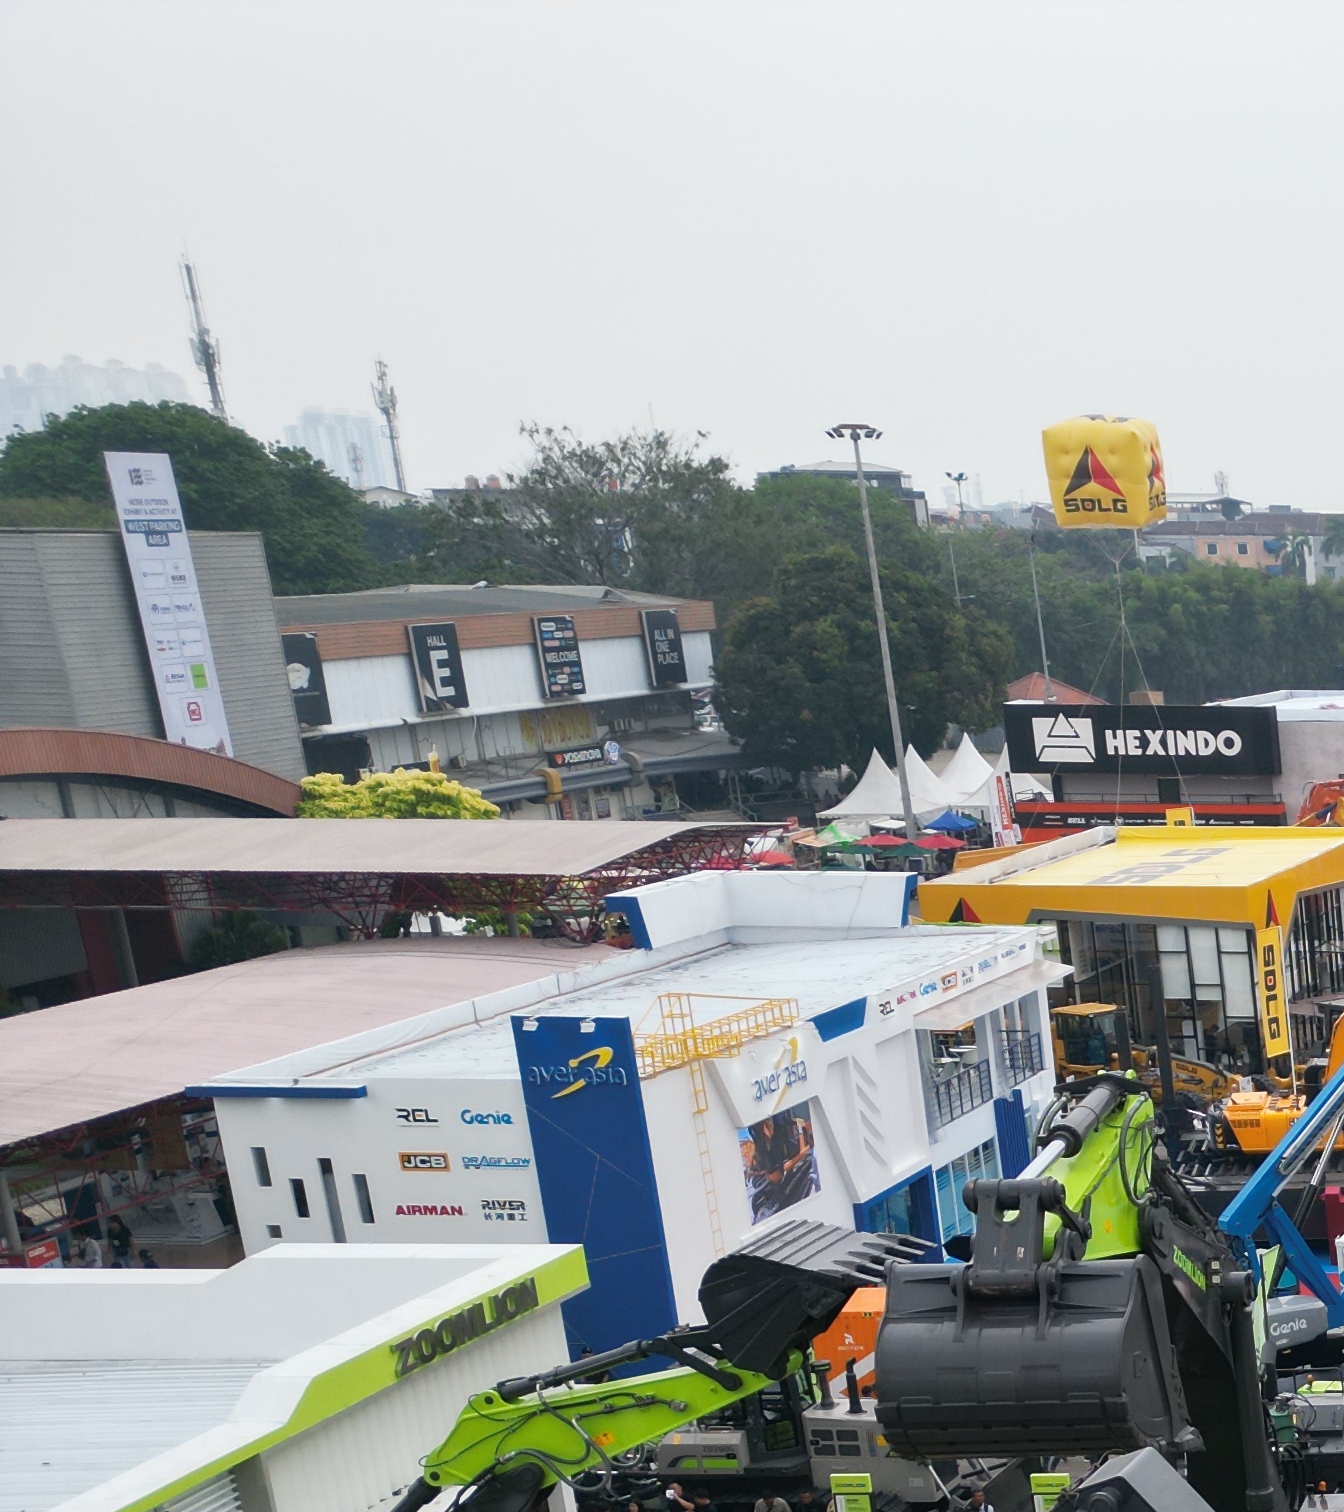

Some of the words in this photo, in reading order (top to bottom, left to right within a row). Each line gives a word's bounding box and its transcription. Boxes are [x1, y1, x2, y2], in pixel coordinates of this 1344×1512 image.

[427, 635, 447, 647] HALL
[654, 629, 667, 641] ALL
[667, 628, 675, 639] IN
[655, 641, 670, 653] ONE
[545, 651, 578, 663] WELCOME
[657, 652, 680, 665] PLACE
[429, 650, 456, 698] E
[1105, 729, 1242, 757] HEXINDO
[1262, 943, 1281, 1041] SDLG
[528, 1064, 576, 1088] aver
[584, 1065, 628, 1088] asia
[753, 1072, 780, 1102] aver
[784, 1060, 808, 1090] asia
[460, 1108, 514, 1126] Genie
[404, 1154, 446, 1170] JCB
[395, 1204, 464, 1217] AIRMAN
[393, 1278, 539, 1378] ZOOMLION
[1270, 1316, 1309, 1337] Genie
